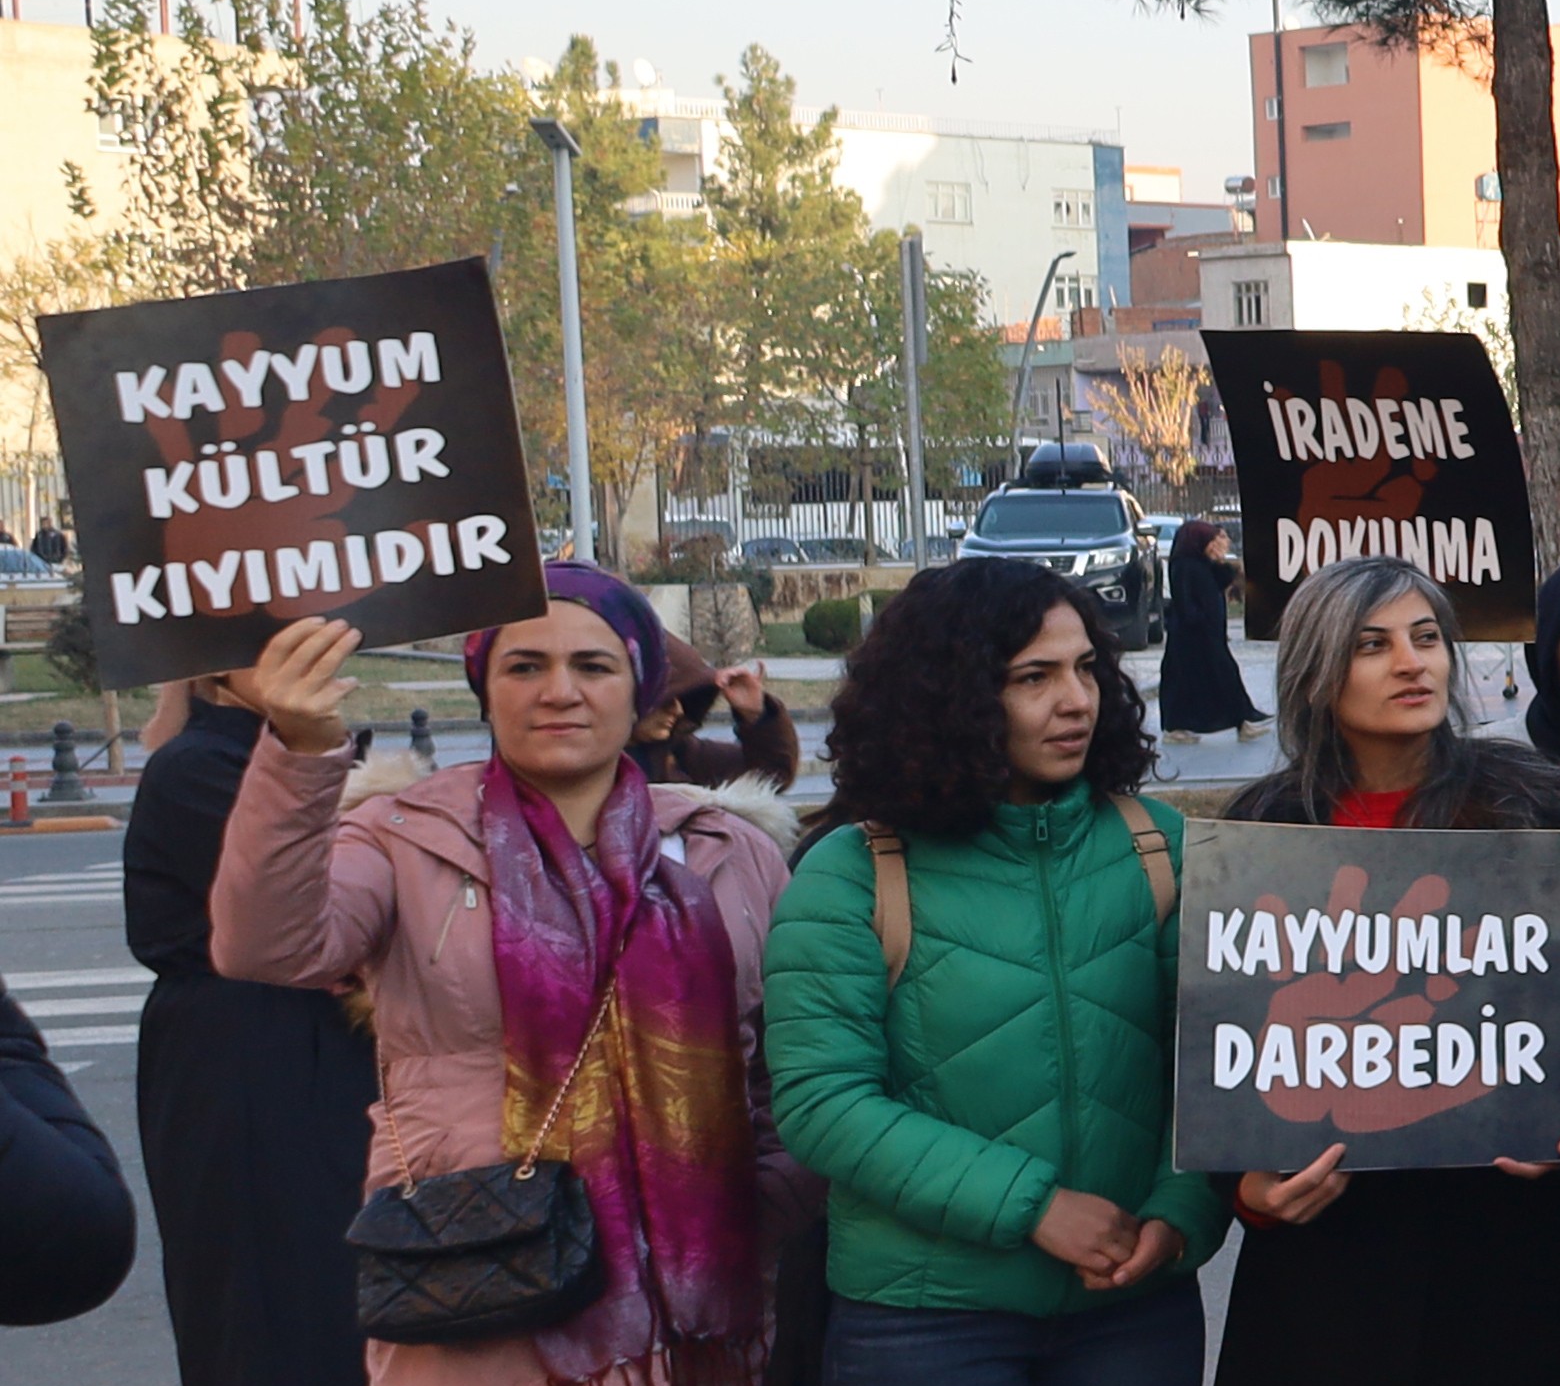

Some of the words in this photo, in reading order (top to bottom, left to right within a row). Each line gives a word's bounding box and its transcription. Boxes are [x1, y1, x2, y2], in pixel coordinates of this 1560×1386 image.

[116, 332, 441, 424] KAYYUM
[1264, 381, 1474, 462] İRADEME
[144, 421, 450, 518] KÜLTÜR
[110, 512, 513, 626] KIYIMIDIR
[1277, 515, 1502, 586] DOKUNMA
[1206, 907, 1549, 976] KAYYUMLAR
[1214, 1004, 1545, 1093] DARBEDİR
